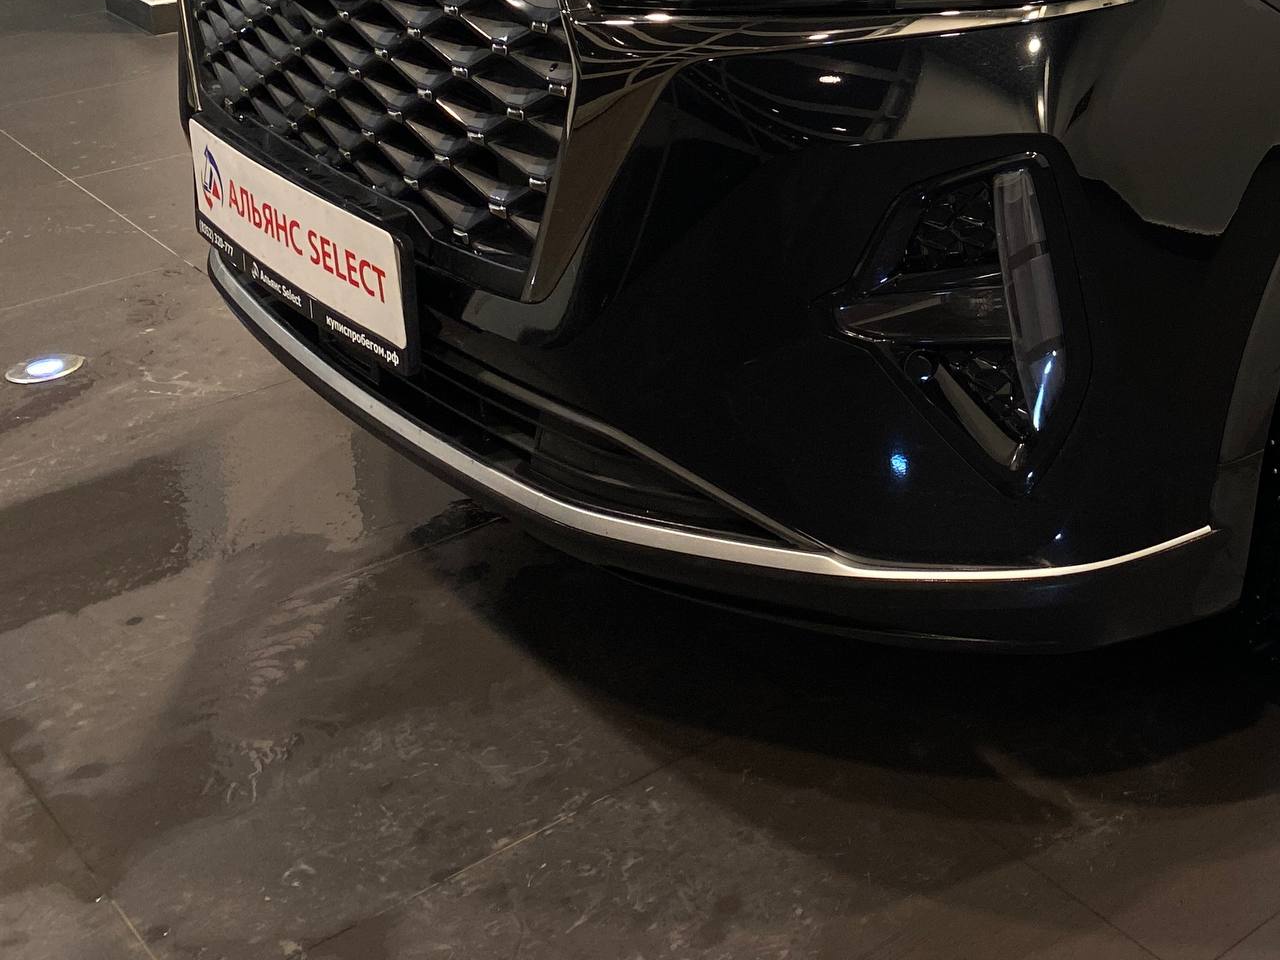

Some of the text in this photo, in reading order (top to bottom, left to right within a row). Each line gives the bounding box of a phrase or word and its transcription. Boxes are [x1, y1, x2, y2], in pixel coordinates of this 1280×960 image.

[228, 178, 387, 305] АЛЬЯНС SELECT
[281, 284, 302, 307] Select
[326, 315, 400, 367] куписпробегом.рф
